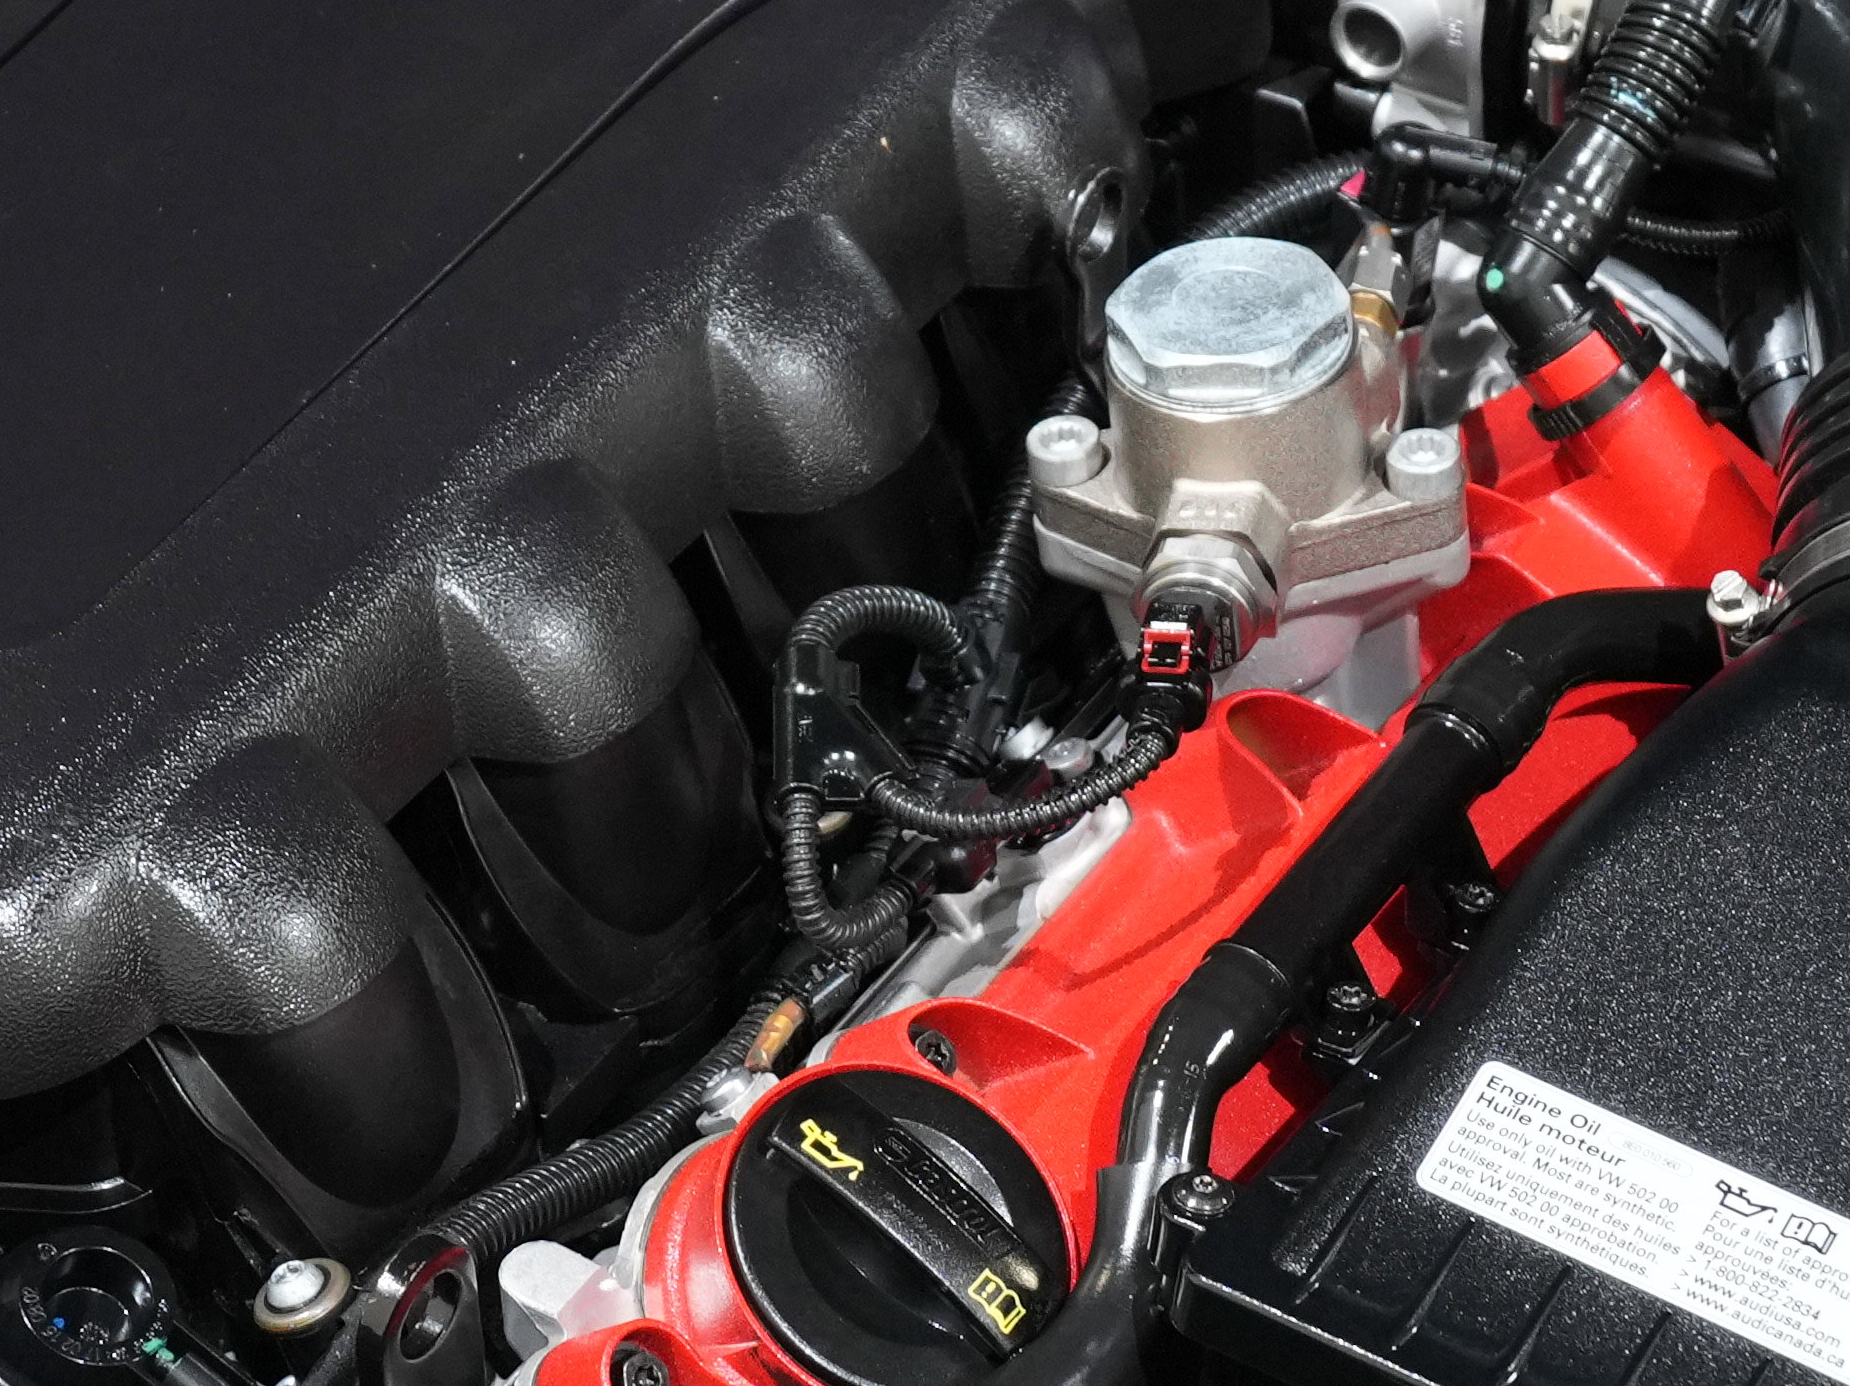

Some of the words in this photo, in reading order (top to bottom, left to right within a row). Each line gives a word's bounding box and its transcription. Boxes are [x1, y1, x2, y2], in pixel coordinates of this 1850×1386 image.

[1476, 1091, 1532, 1126] Huile
[1538, 1123, 1626, 1166] moteur
[1485, 1075, 1562, 1118] Engine
[1569, 1113, 1602, 1136] Oil
[1448, 1140, 1502, 1174] Utilisez
[1506, 1170, 1599, 1218] uniquement
[1602, 1213, 1630, 1231] des
[1633, 1225, 1681, 1255] huiles
[1457, 1126, 1526, 1164] approval.
[1532, 1157, 1572, 1184] Most
[1574, 1180, 1599, 1196] are
[1603, 1192, 1675, 1232] synthetic.
[1466, 1109, 1495, 1130] Use
[1499, 1127, 1532, 1149] only
[1535, 1144, 1557, 1158] oil
[1559, 1154, 1592, 1175] with
[1598, 1168, 1626, 1188] VW
[1627, 1183, 1656, 1203] 502
[1659, 1198, 1679, 1213] 00
[1429, 1167, 1448, 1185] La
[1449, 1181, 1507, 1212] plupart
[1509, 1207, 1545, 1229] sont
[1547, 1224, 1651, 1277] synthétiques.
[1438, 1157, 1474, 1178] avec
[1480, 1171, 1508, 1192] VW
[1508, 1186, 1537, 1207] 502
[1539, 1201, 1560, 1217] 00
[1561, 1214, 1660, 1264] approbation.
[1710, 1210, 1737, 1230] For
[1740, 1228, 1750, 1237] a
[1754, 1231, 1779, 1250] list
[1782, 1246, 1801, 1259] of
[1694, 1241, 1789, 1291] approuvées:
[1702, 1224, 1740, 1248] Pour
[1744, 1246, 1773, 1264] une
[1777, 1258, 1810, 1282] liste
[1705, 1259, 1821, 1320] 1-800-822-2834
[1686, 1288, 1845, 1368] www.audicanada.ca
[1694, 1274, 1840, 1348] www.audiusa.com
